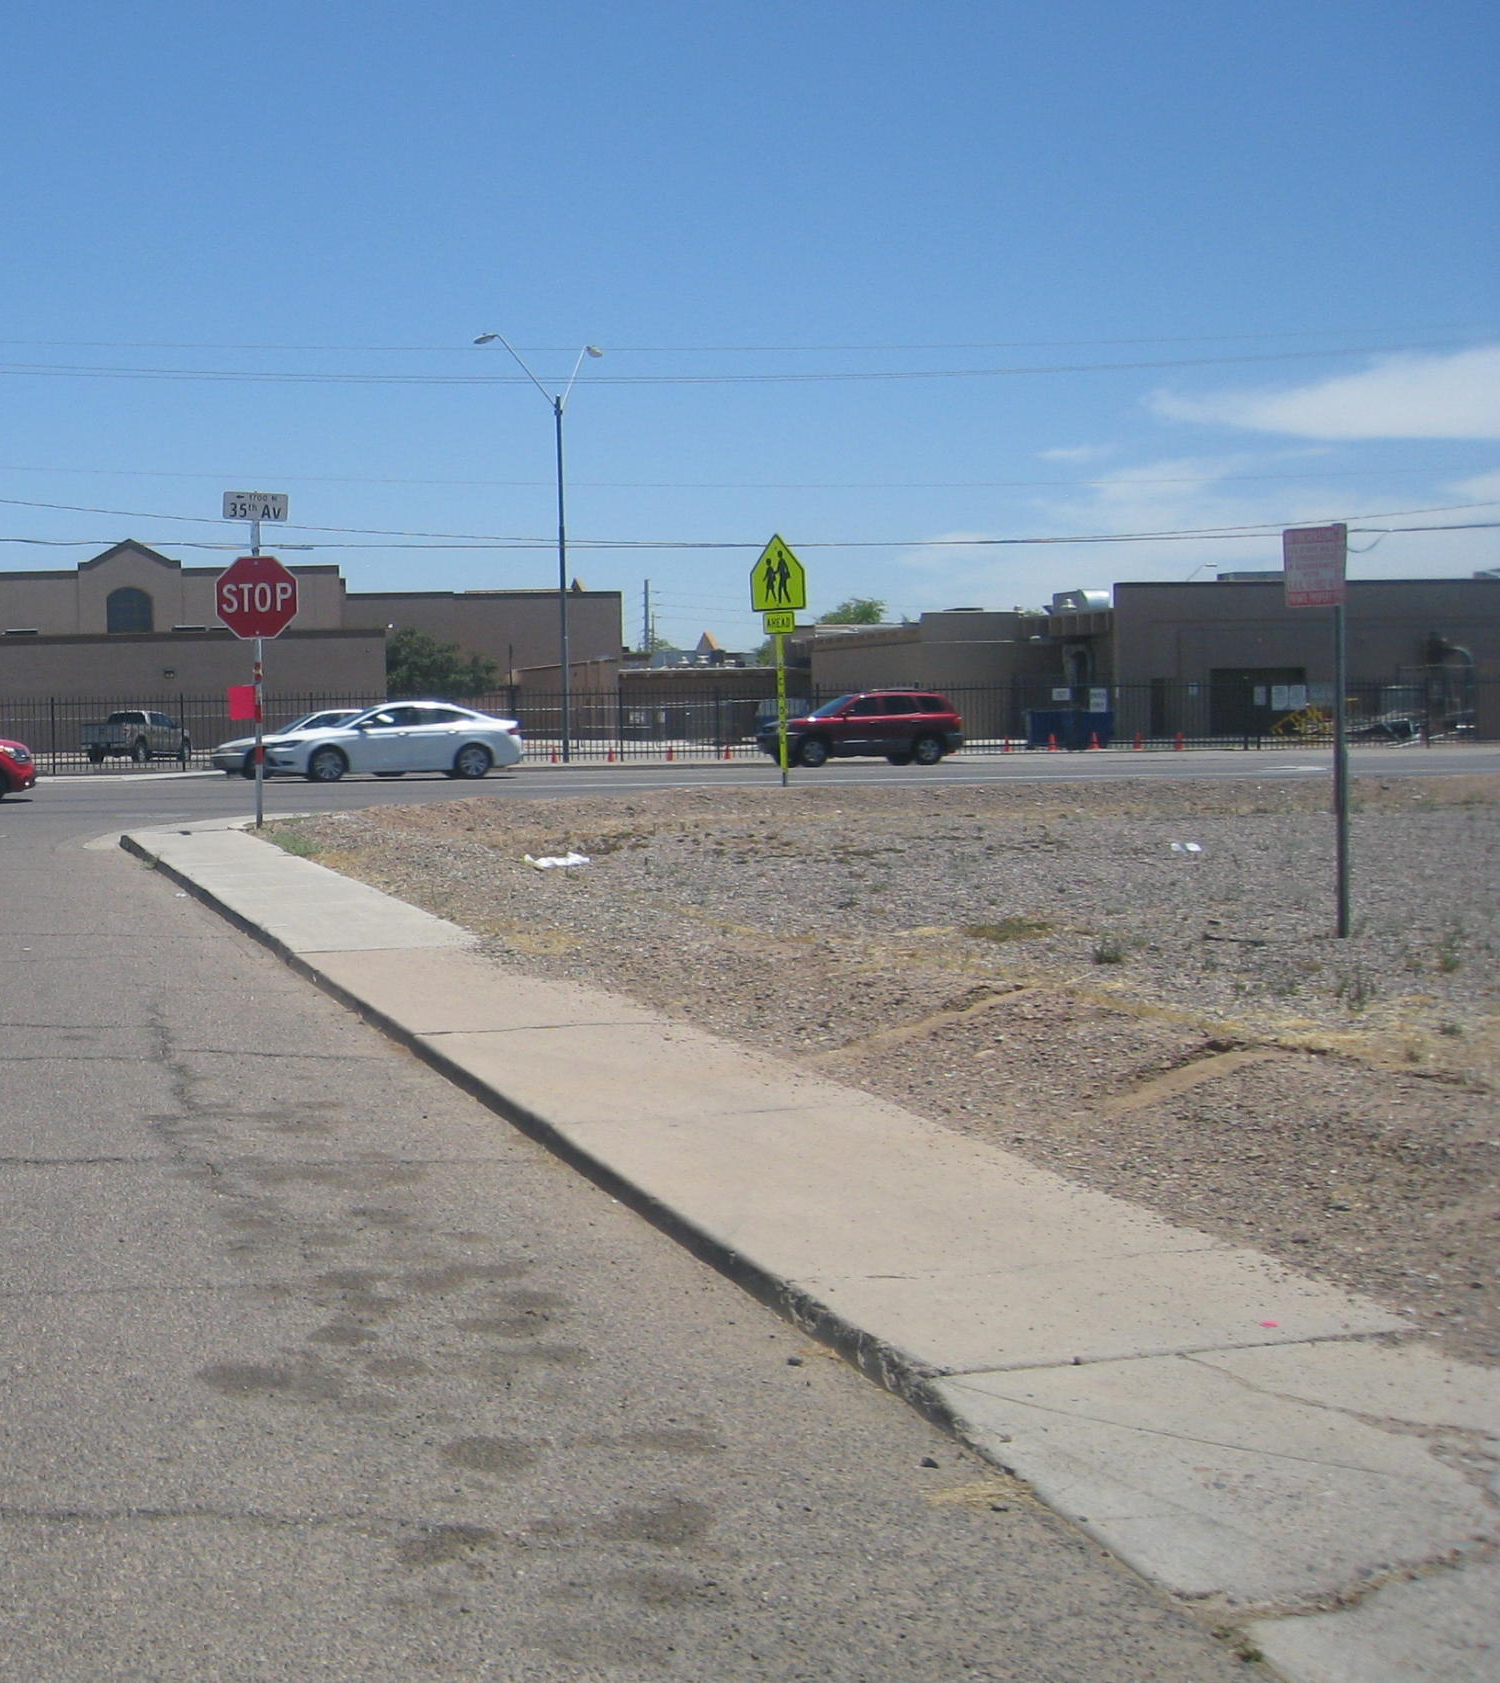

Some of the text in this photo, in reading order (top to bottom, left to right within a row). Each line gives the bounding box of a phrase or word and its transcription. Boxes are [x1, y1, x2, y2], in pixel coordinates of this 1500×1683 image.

[229, 502, 282, 519] 35th Av
[222, 582, 292, 613] STOP
[767, 617, 790, 628] AHEAD
